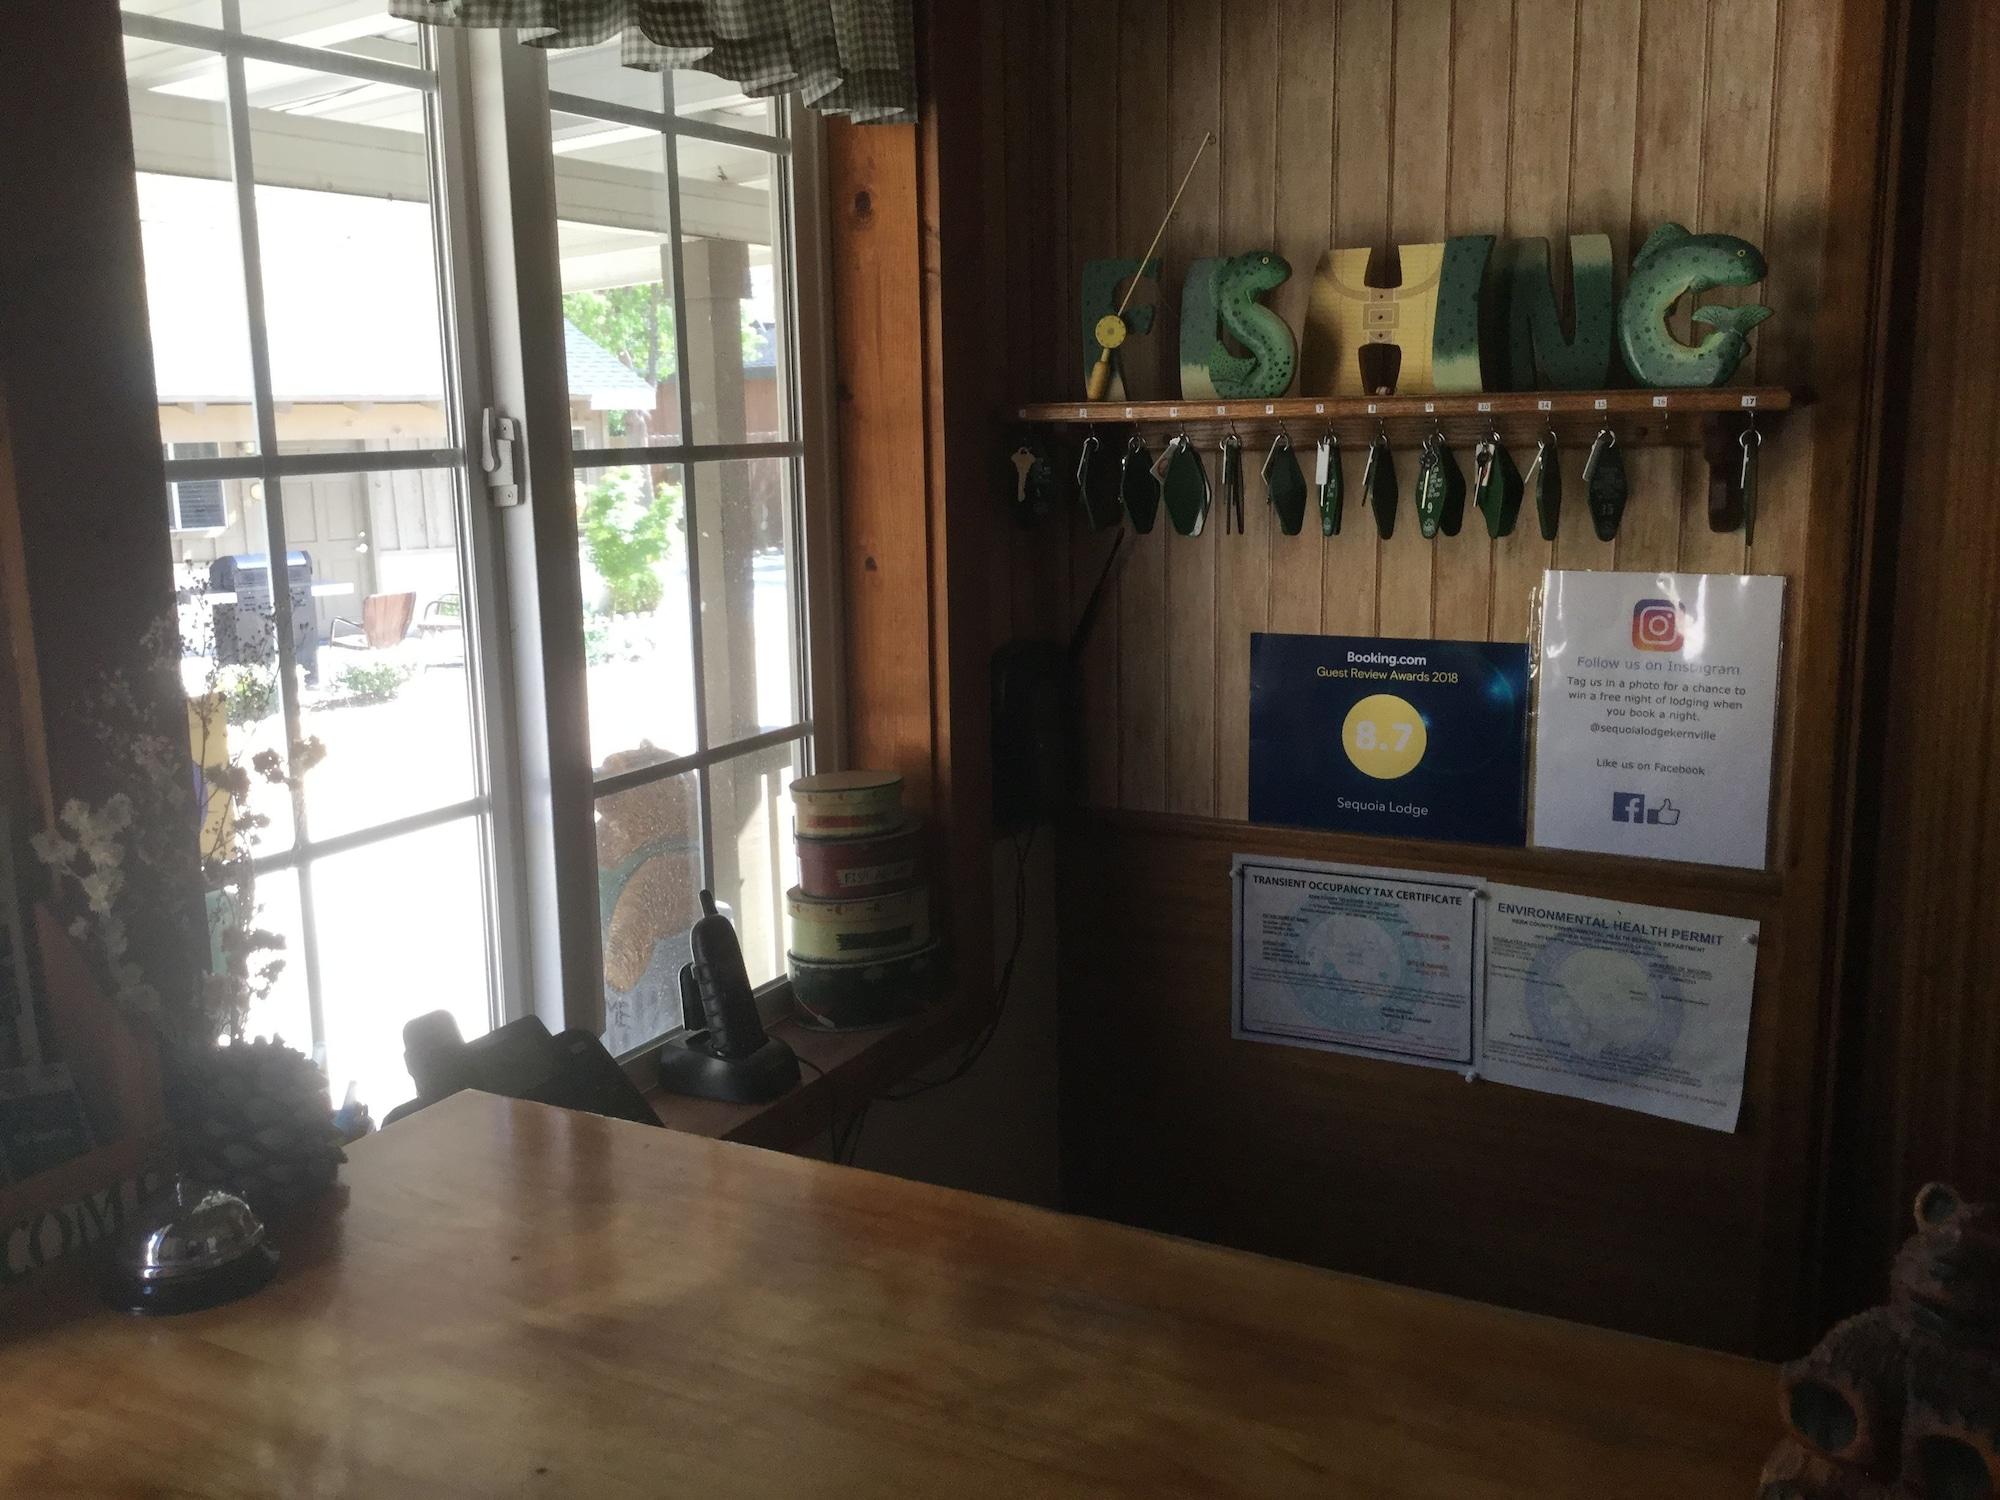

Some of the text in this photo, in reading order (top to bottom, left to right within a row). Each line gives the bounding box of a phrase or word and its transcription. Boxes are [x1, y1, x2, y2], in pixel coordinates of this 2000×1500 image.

[1081, 220, 1773, 402] FISHING
[1427, 501, 1433, 513] 9
[1347, 651, 1427, 667] Booking.com
[1577, 656, 1619, 669] Follow
[1625, 661, 1640, 670] us
[1645, 661, 1662, 671] on
[1316, 666, 1458, 683] Guest Review Awards 2018
[1567, 676, 1586, 688] Tag
[1590, 678, 1602, 687] us
[1606, 677, 1615, 687] in
[1629, 678, 1660, 691] photo
[1663, 681, 1679, 691] for
[1692, 683, 1731, 695] chance
[1735, 686, 1746, 696] to
[1568, 691, 1586, 700] win
[1600, 692, 1621, 702] free
[1625, 693, 1651, 705] night
[1655, 695, 1666, 705] of
[1670, 696, 1709, 710] lodging
[1713, 700, 1743, 710] when
[1606, 708, 1625, 717] you
[1629, 708, 1655, 718] book
[1669, 711, 1700, 722] night.
[1355, 720, 1413, 752] 8.7
[1590, 722, 1716, 741] @sequoialodgekernville
[1596, 758, 1705, 776] Like us on Facebook
[1337, 796, 1428, 817] Sequoia Lodge
[1253, 874, 1306, 889] TRANSIENT
[1308, 880, 1370, 896] OCCUPANCY
[1373, 887, 1393, 898] TAX
[1396, 889, 1463, 906] CERTIFICATE
[1498, 902, 1609, 929] ENVIRONMENTAL
[1613, 920, 1667, 938] HEALTH
[1672, 927, 1724, 946] PERMIT
